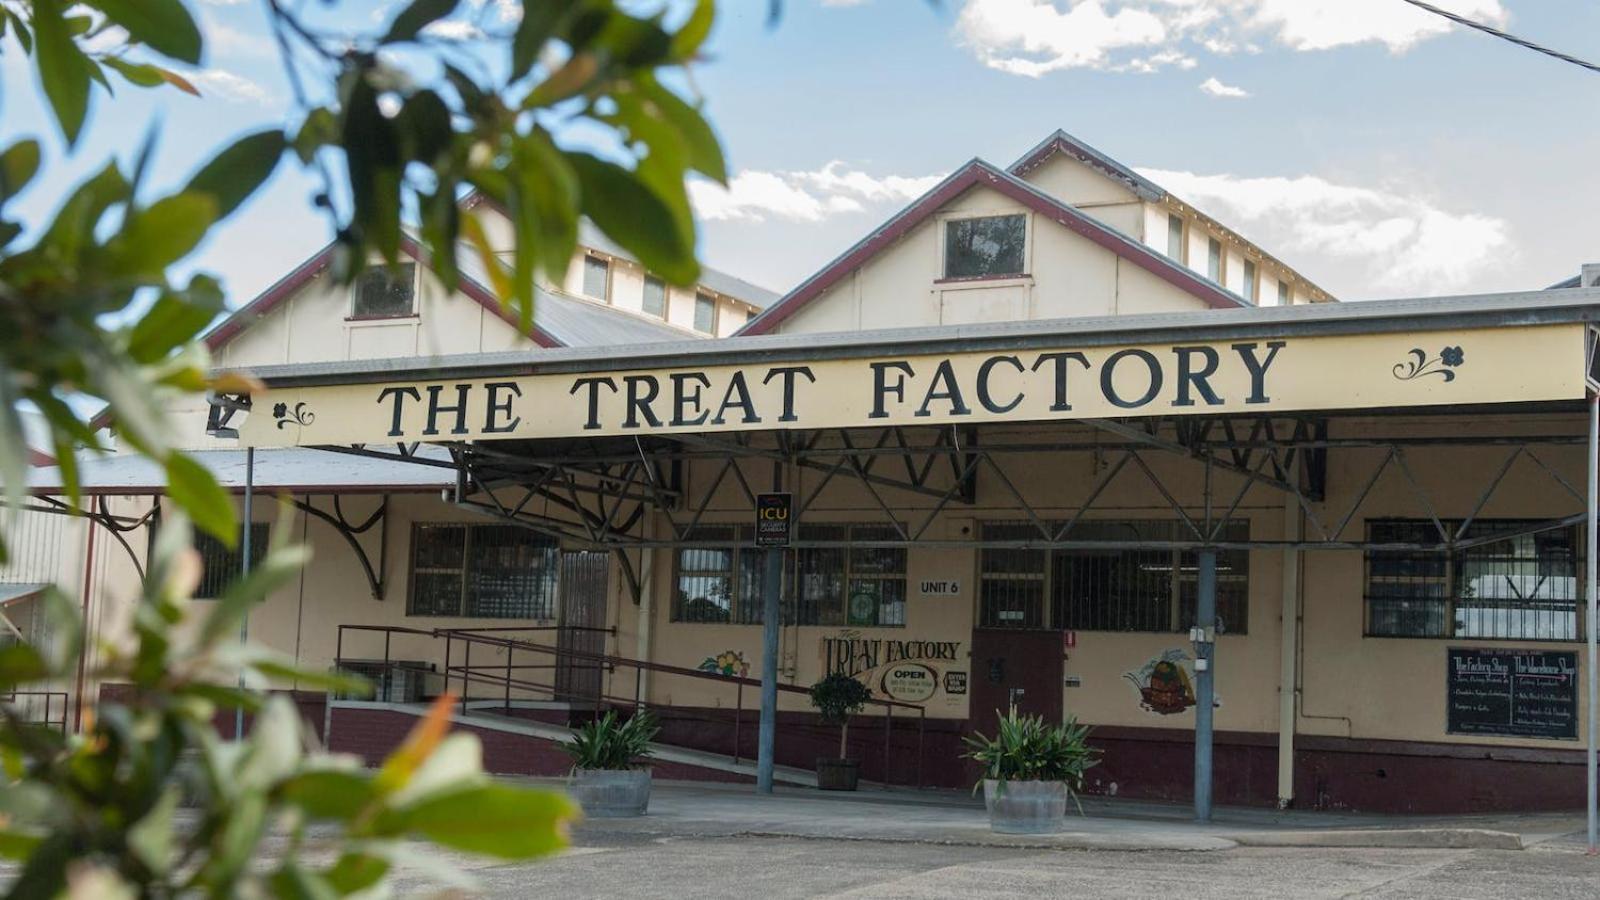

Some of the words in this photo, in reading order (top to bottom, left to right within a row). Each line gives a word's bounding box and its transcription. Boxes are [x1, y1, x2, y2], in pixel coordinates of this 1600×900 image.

[376, 381, 523, 437] THE
[569, 366, 817, 431] TREAT
[868, 341, 1287, 418] FACTORY
[759, 507, 787, 520] ICU
[921, 581, 948, 593] UNIT
[950, 581, 958, 594] 6
[823, 637, 882, 678] TREAT
[887, 640, 960, 662] FACTORY
[1454, 657, 1467, 672] The
[1467, 656, 1491, 678] Factory
[1491, 657, 1509, 678] Shop
[894, 670, 925, 680] OPEN
[1513, 656, 1527, 674] The
[1527, 656, 1559, 675] Warehouse
[1558, 657, 1575, 686] Shop
